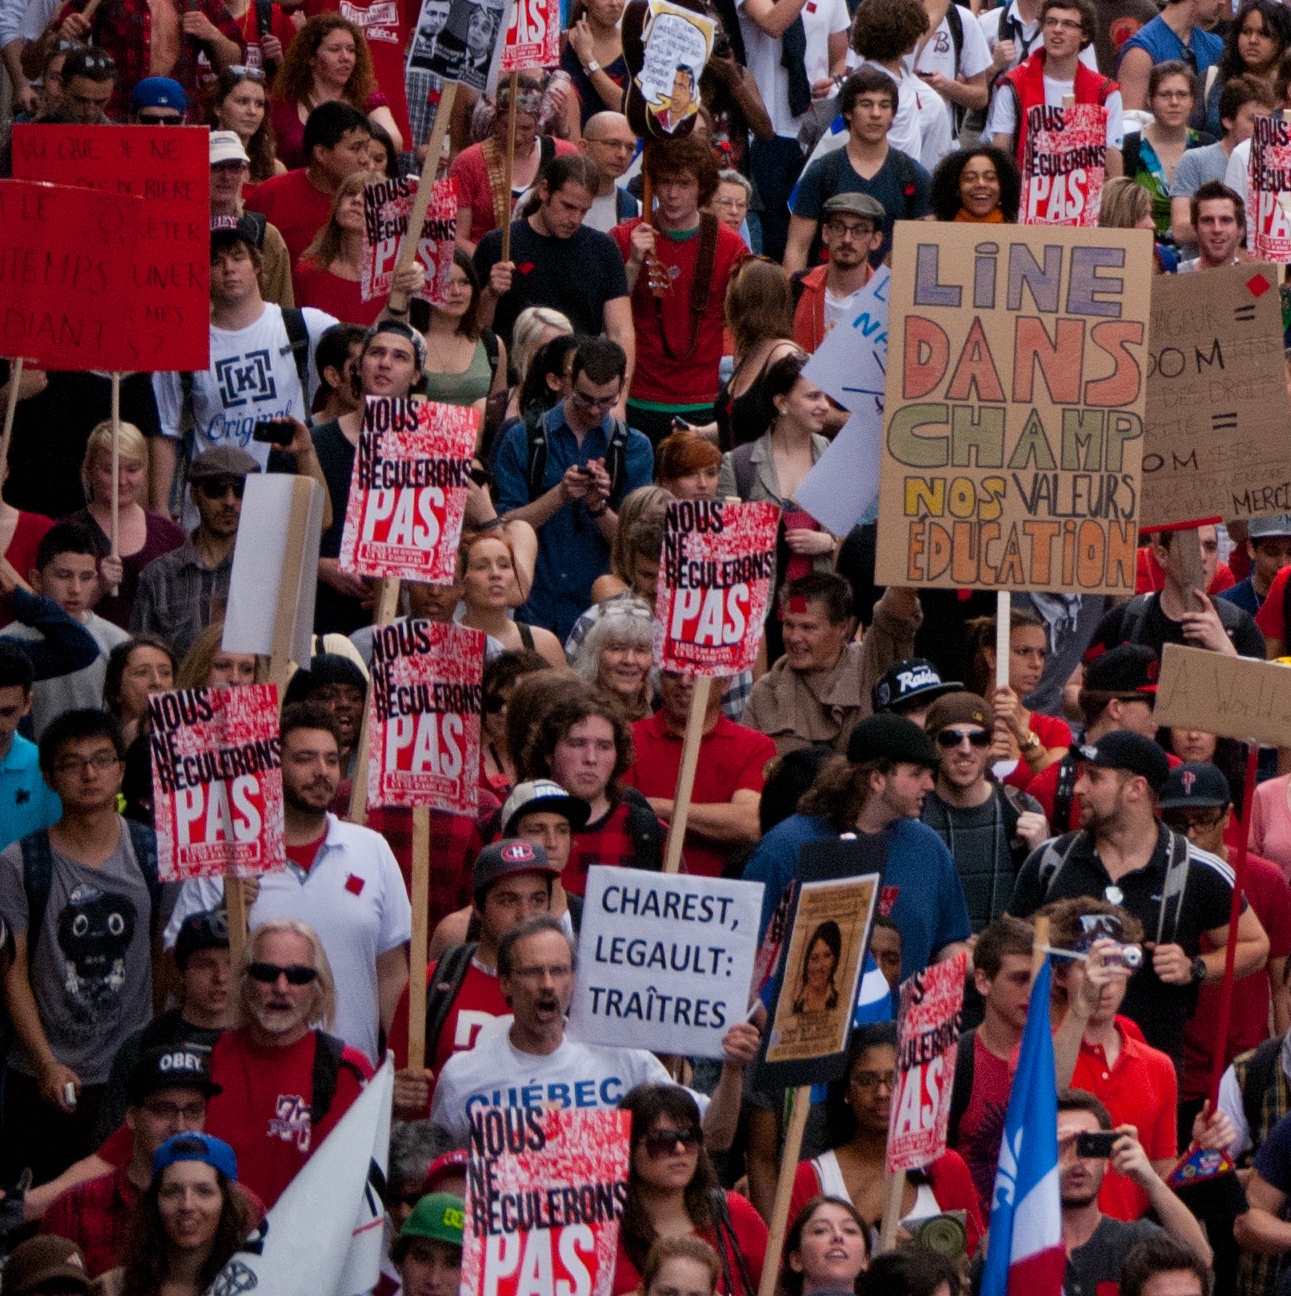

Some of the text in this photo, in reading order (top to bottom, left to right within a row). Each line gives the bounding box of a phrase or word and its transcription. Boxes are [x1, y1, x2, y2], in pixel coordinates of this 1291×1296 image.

[903, 316, 1143, 403] DANS
[363, 397, 420, 433] NOUS
[887, 404, 1143, 471] CHAMP
[362, 487, 445, 548] PAS
[665, 501, 722, 535] NOUS
[904, 472, 1136, 519] NOS VALEURS
[670, 584, 747, 644] PAS
[372, 620, 431, 663] NOUS
[148, 691, 213, 735] NOUS
[385, 712, 464, 777] PAS
[176, 775, 261, 844] PAS
[602, 886, 739, 930] CHAREST,
[595, 935, 733, 977] LEGAULT:
[589, 985, 725, 1029] TRAÎTRES
[469, 1105, 546, 1155] NOUS
[472, 1181, 629, 1237] RECULERONS
[482, 1224, 594, 1296] PAS
